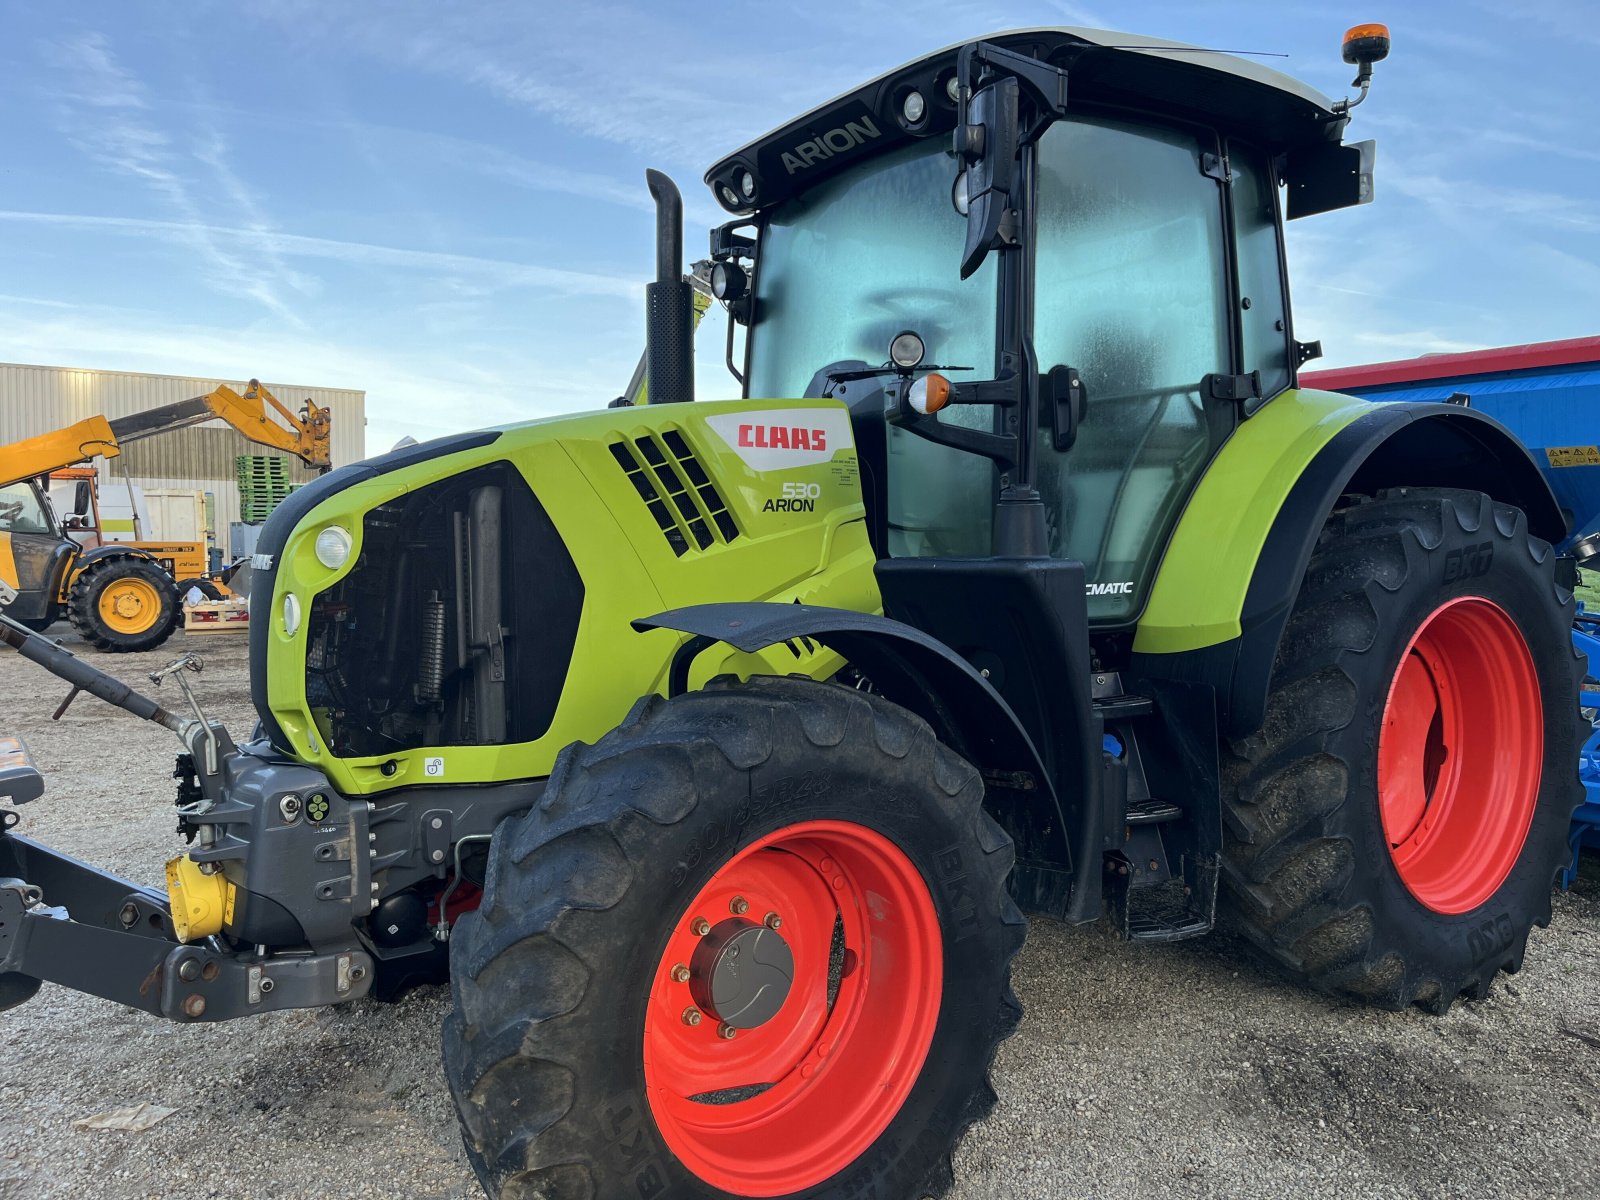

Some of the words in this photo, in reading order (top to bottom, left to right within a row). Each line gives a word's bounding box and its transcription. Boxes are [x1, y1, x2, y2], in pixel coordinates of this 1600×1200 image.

[738, 424, 826, 452] CLAAS
[782, 482, 821, 499] 530
[762, 498, 815, 513] ARION
[1442, 541, 1494, 586] BKT
